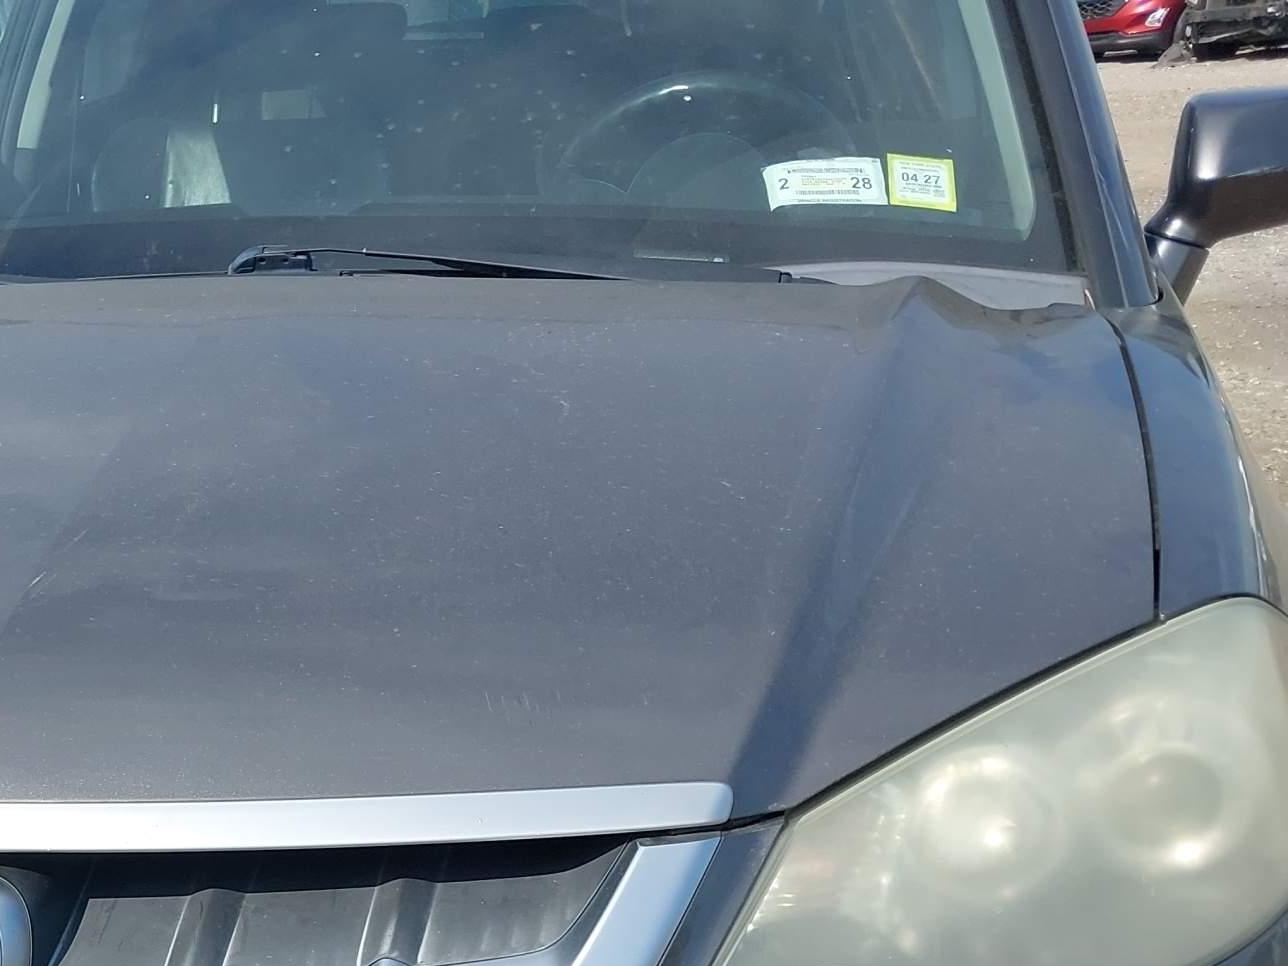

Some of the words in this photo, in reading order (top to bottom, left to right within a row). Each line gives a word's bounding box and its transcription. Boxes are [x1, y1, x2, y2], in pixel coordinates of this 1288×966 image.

[778, 178, 790, 190] 2
[850, 176, 873, 190] 28
[901, 172, 919, 183] 04
[923, 174, 941, 185] 27
